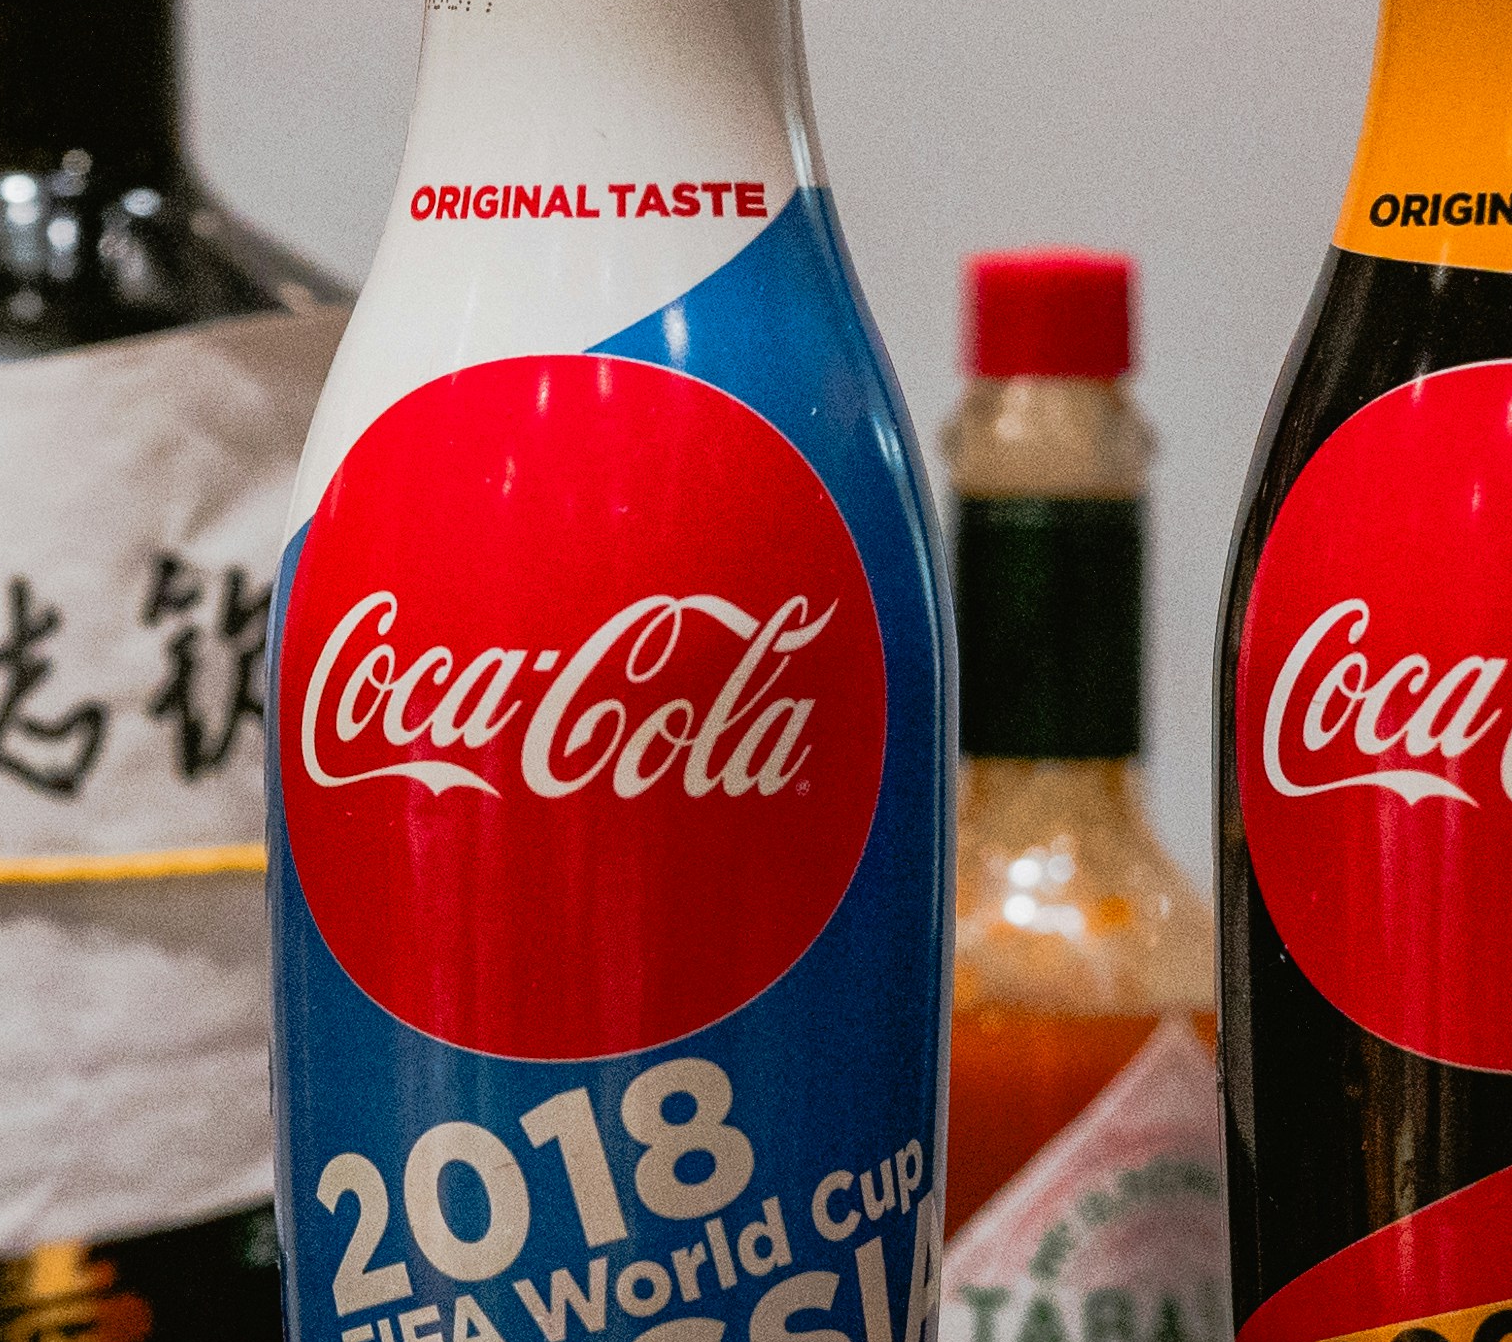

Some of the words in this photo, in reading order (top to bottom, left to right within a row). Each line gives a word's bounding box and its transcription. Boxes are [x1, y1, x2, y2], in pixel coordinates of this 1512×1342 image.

[408, 184, 601, 221] ORIGINAL
[608, 181, 769, 220] TASTE
[300, 590, 840, 800] Coca-Cola
[315, 1056, 756, 1318] 2018
[810, 1138, 925, 1242] Cup
